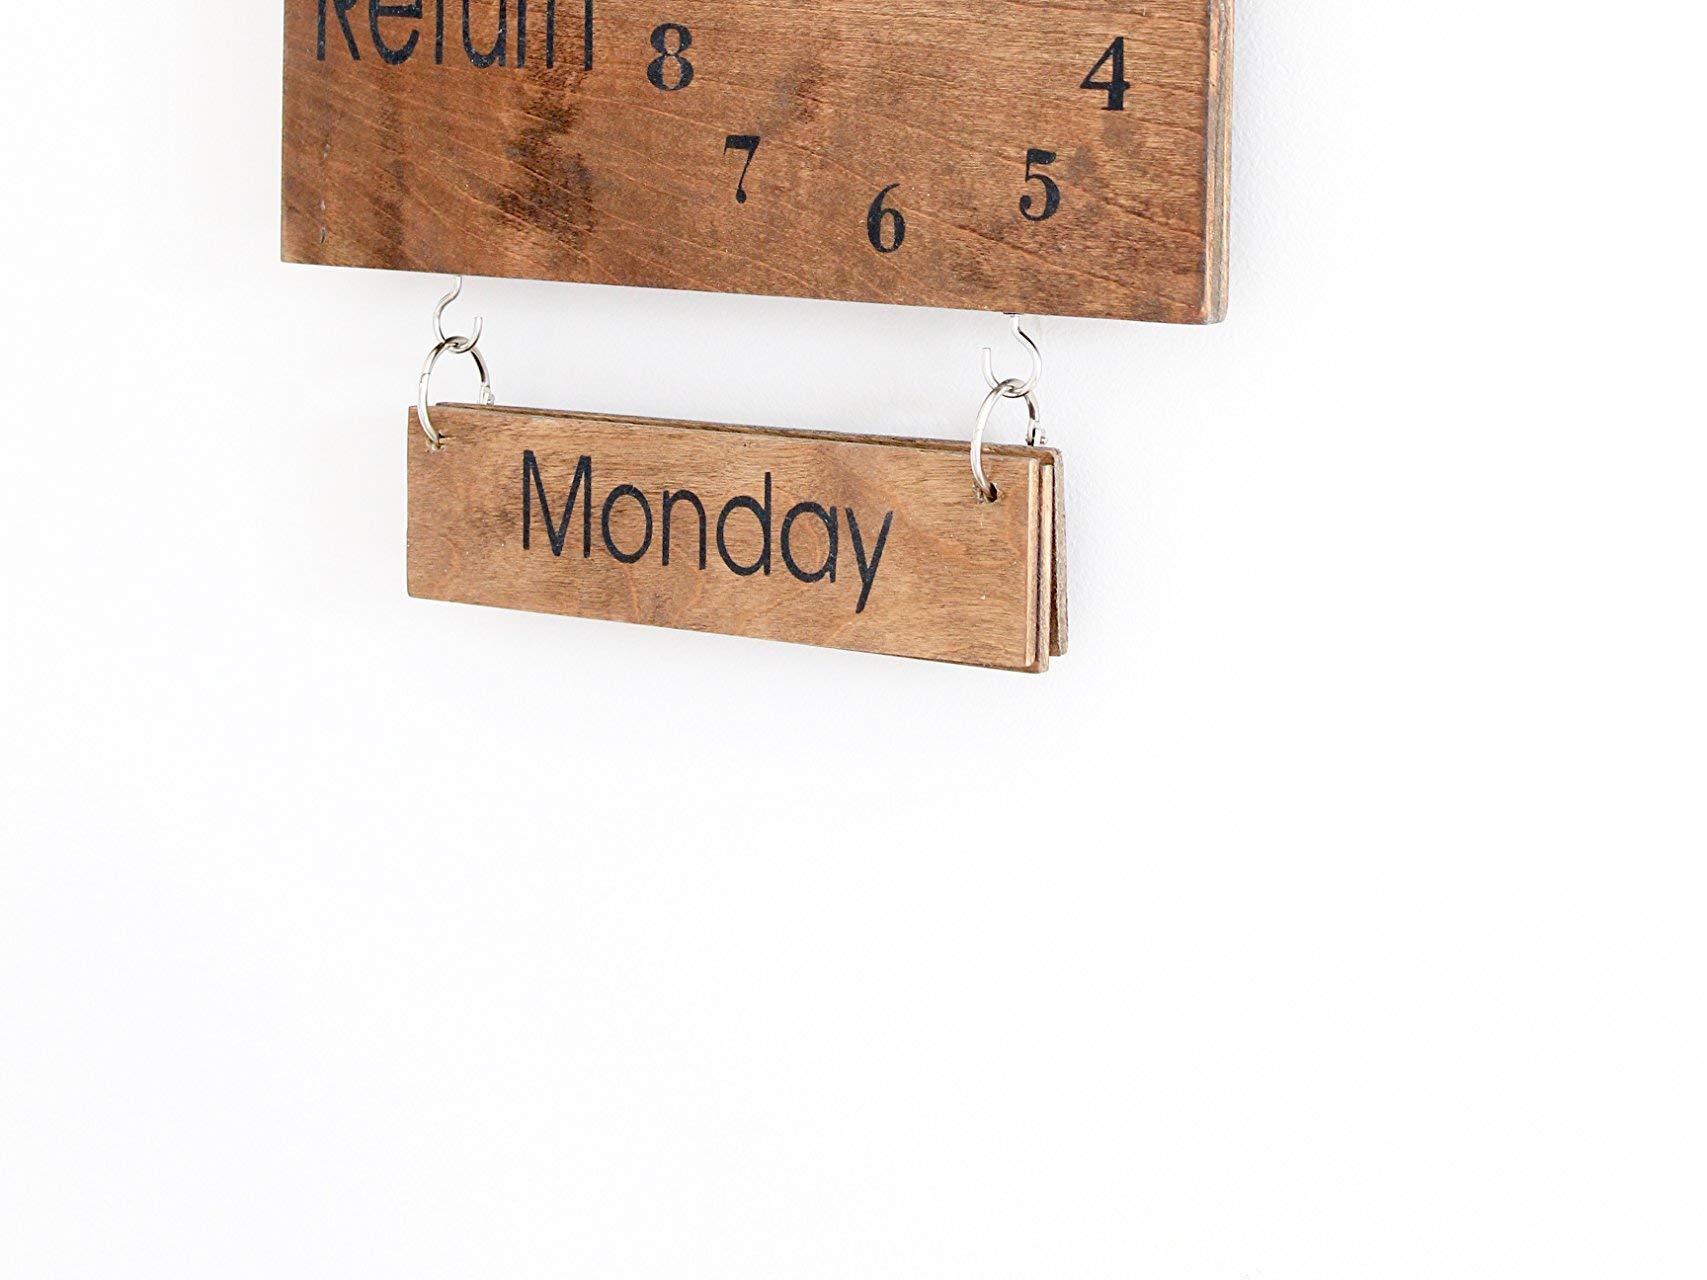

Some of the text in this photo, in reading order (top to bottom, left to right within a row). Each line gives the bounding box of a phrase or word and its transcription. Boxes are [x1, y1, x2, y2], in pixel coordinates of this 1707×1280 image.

[646, 22, 694, 90] 8
[1081, 37, 1131, 111] 4
[724, 135, 761, 204] 7
[1020, 149, 1060, 222] 5
[866, 183, 906, 253] 6
[522, 449, 893, 614] Monday
